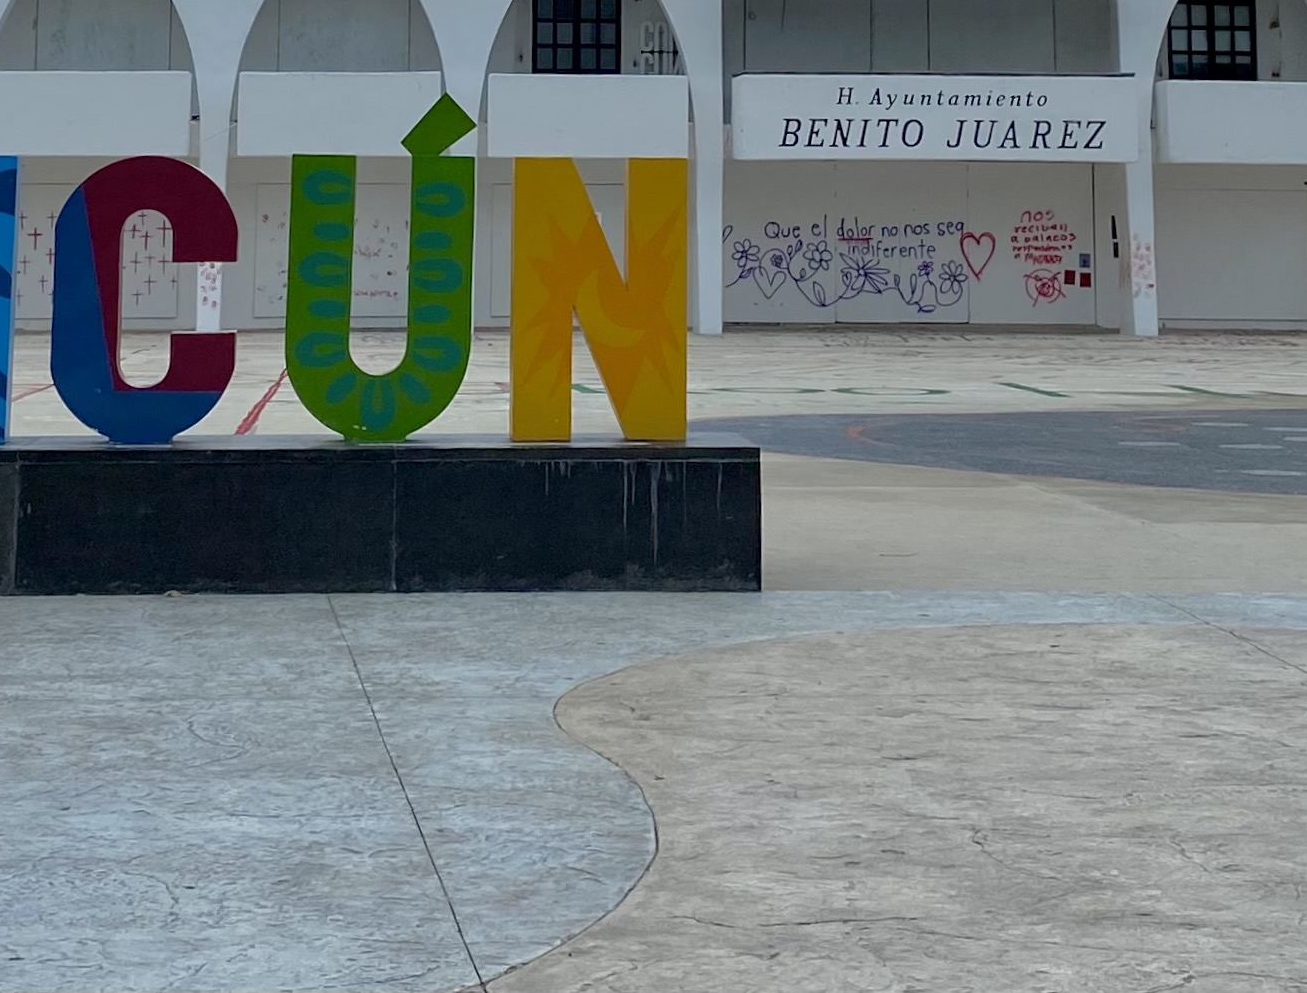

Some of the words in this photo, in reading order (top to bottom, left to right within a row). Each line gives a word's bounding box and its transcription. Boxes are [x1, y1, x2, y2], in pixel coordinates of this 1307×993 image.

[868, 87, 1049, 111] Ayuntamiento
[778, 118, 925, 148] BENITO
[946, 119, 1107, 150] JUAREZ
[764, 221, 801, 239] Que
[811, 214, 827, 238] el
[836, 216, 874, 238] dolor
[881, 224, 898, 237] no
[904, 223, 930, 238] nos
[937, 220, 965, 237] sea
[847, 238, 936, 259] indiferente
